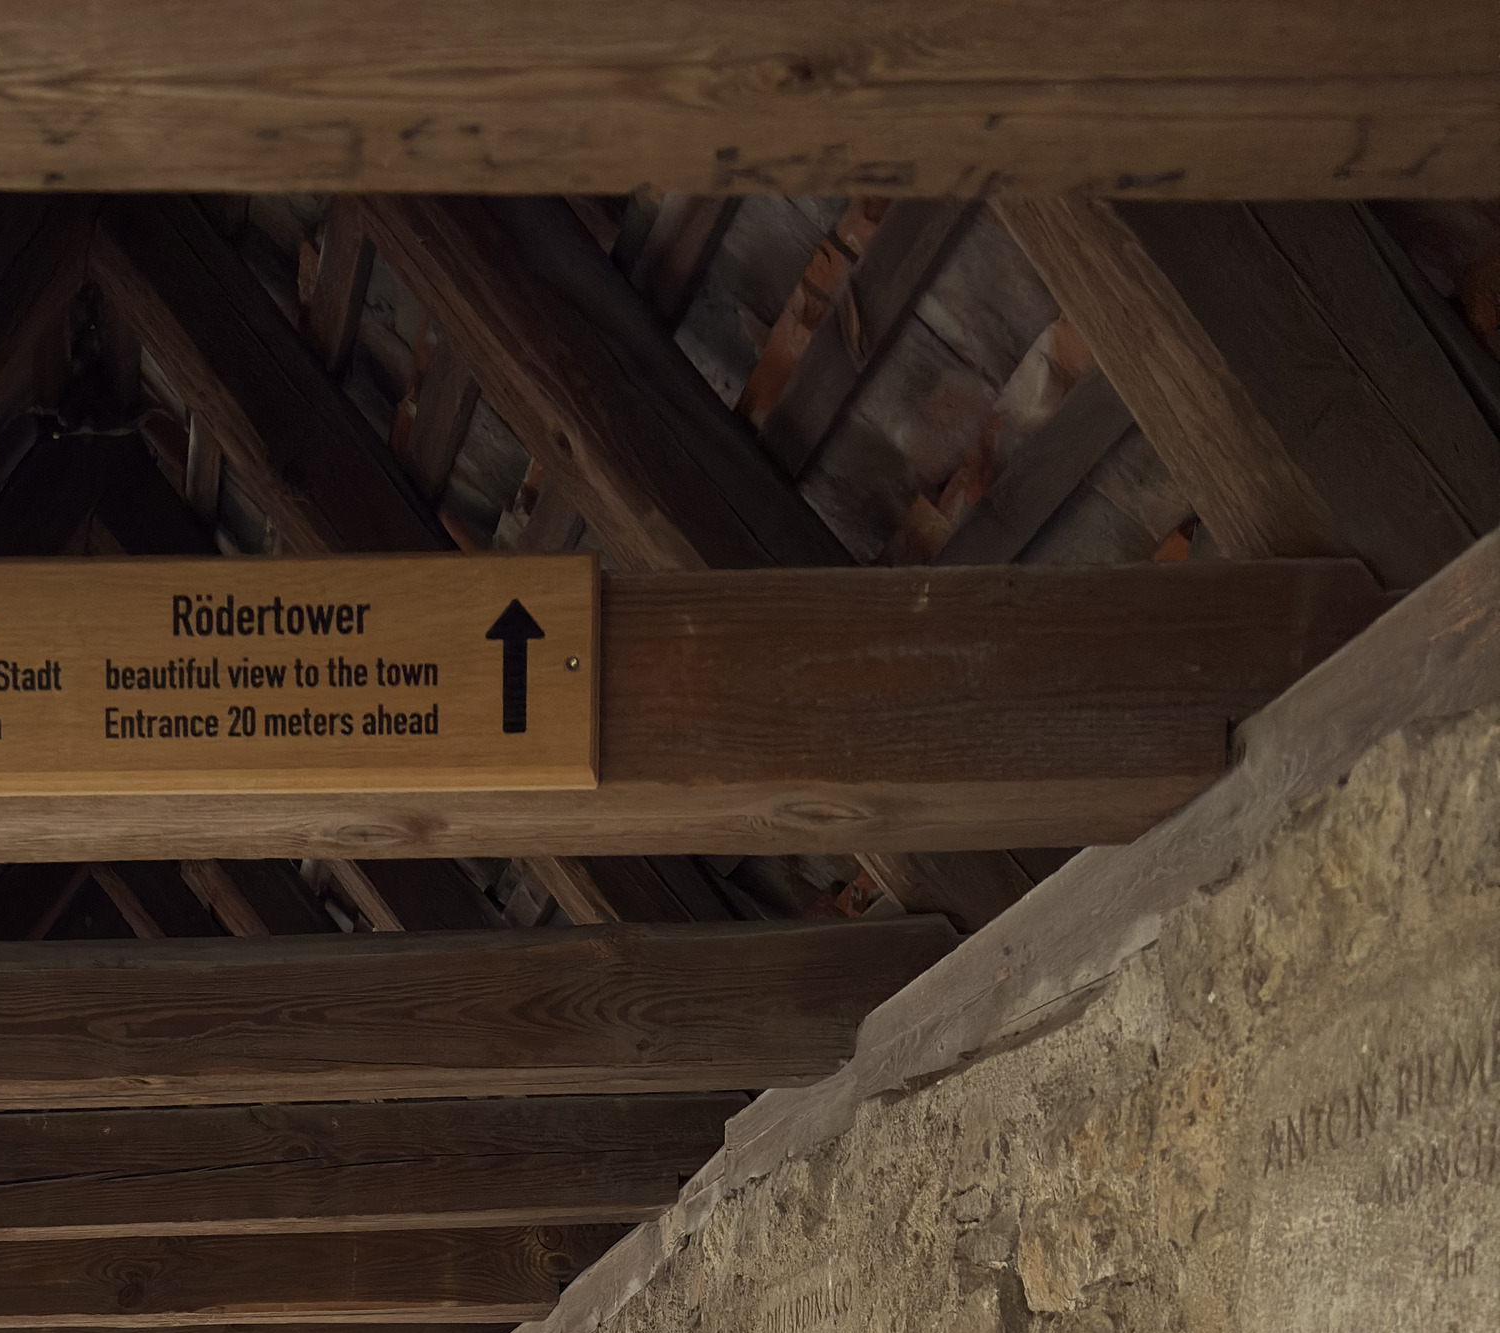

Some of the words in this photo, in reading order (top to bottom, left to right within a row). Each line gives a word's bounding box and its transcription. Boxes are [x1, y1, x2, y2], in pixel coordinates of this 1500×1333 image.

[172, 594, 371, 637] Rödertower
[105, 657, 221, 691] beautiful
[227, 656, 287, 689] view
[293, 658, 320, 688] to
[327, 655, 369, 688] the
[375, 657, 439, 687] town
[104, 706, 219, 739] Entrance
[227, 705, 257, 738] 20
[264, 707, 355, 737] meters
[361, 702, 439, 736] ahead
[1261, 1072, 1380, 1180] ANTON
